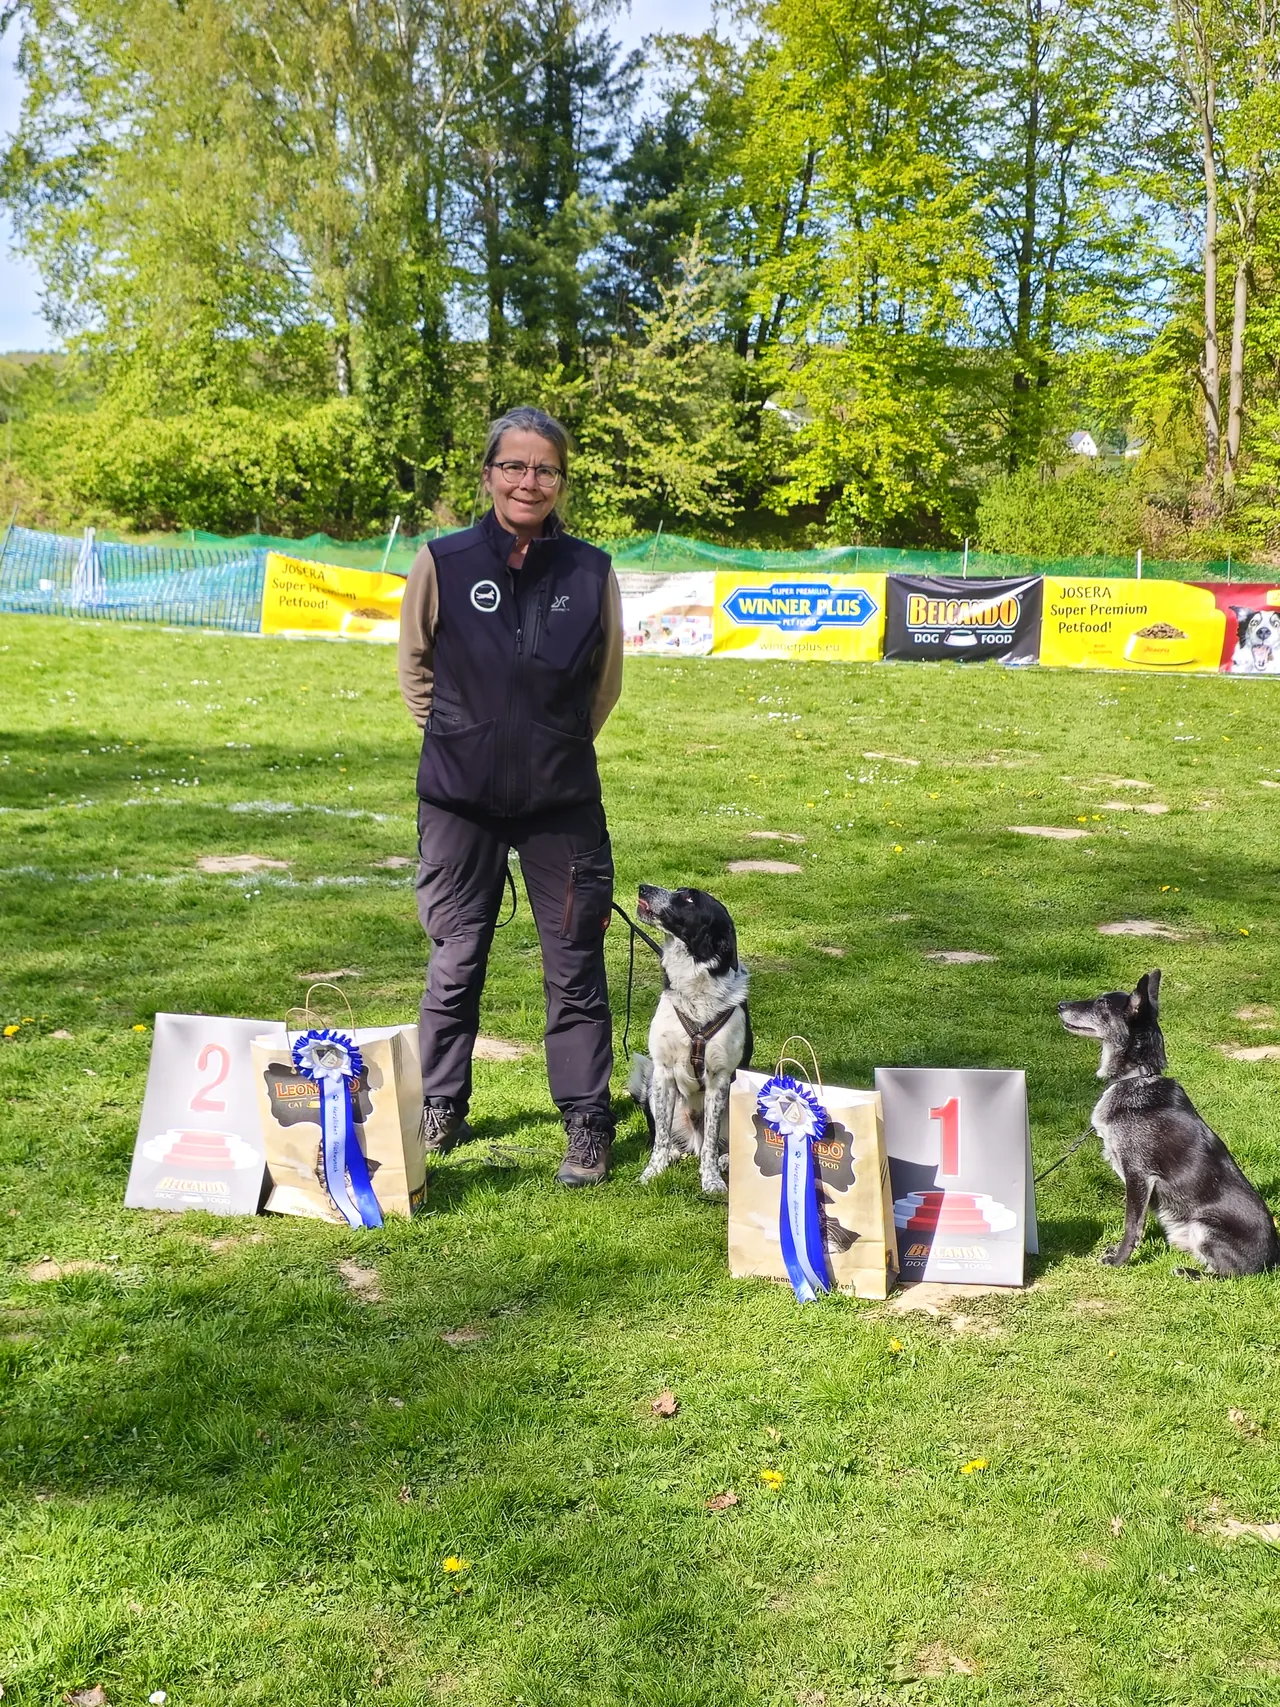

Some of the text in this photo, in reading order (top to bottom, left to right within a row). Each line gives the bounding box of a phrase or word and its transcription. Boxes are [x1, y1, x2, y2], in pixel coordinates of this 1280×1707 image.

[282, 563, 325, 582] JOSERA
[272, 578, 357, 600] Super Premium
[771, 587, 829, 596] SUPER PREMIUM
[1060, 586, 1112, 600] JOSERA
[279, 595, 328, 610] Petfood!
[738, 598, 861, 616] WINNER PLUS
[907, 594, 1020, 628] BELCANDO
[1050, 603, 1148, 618] Super Premium
[1058, 621, 1112, 634] Petfood!
[914, 633, 1012, 644] DOG FOOD
[758, 642, 840, 653] winnerplus.eu
[189, 1043, 231, 1114] 2
[288, 1101, 303, 1109] CAT
[928, 1096, 961, 1177] 1
[904, 1243, 990, 1261] BELCANDO
